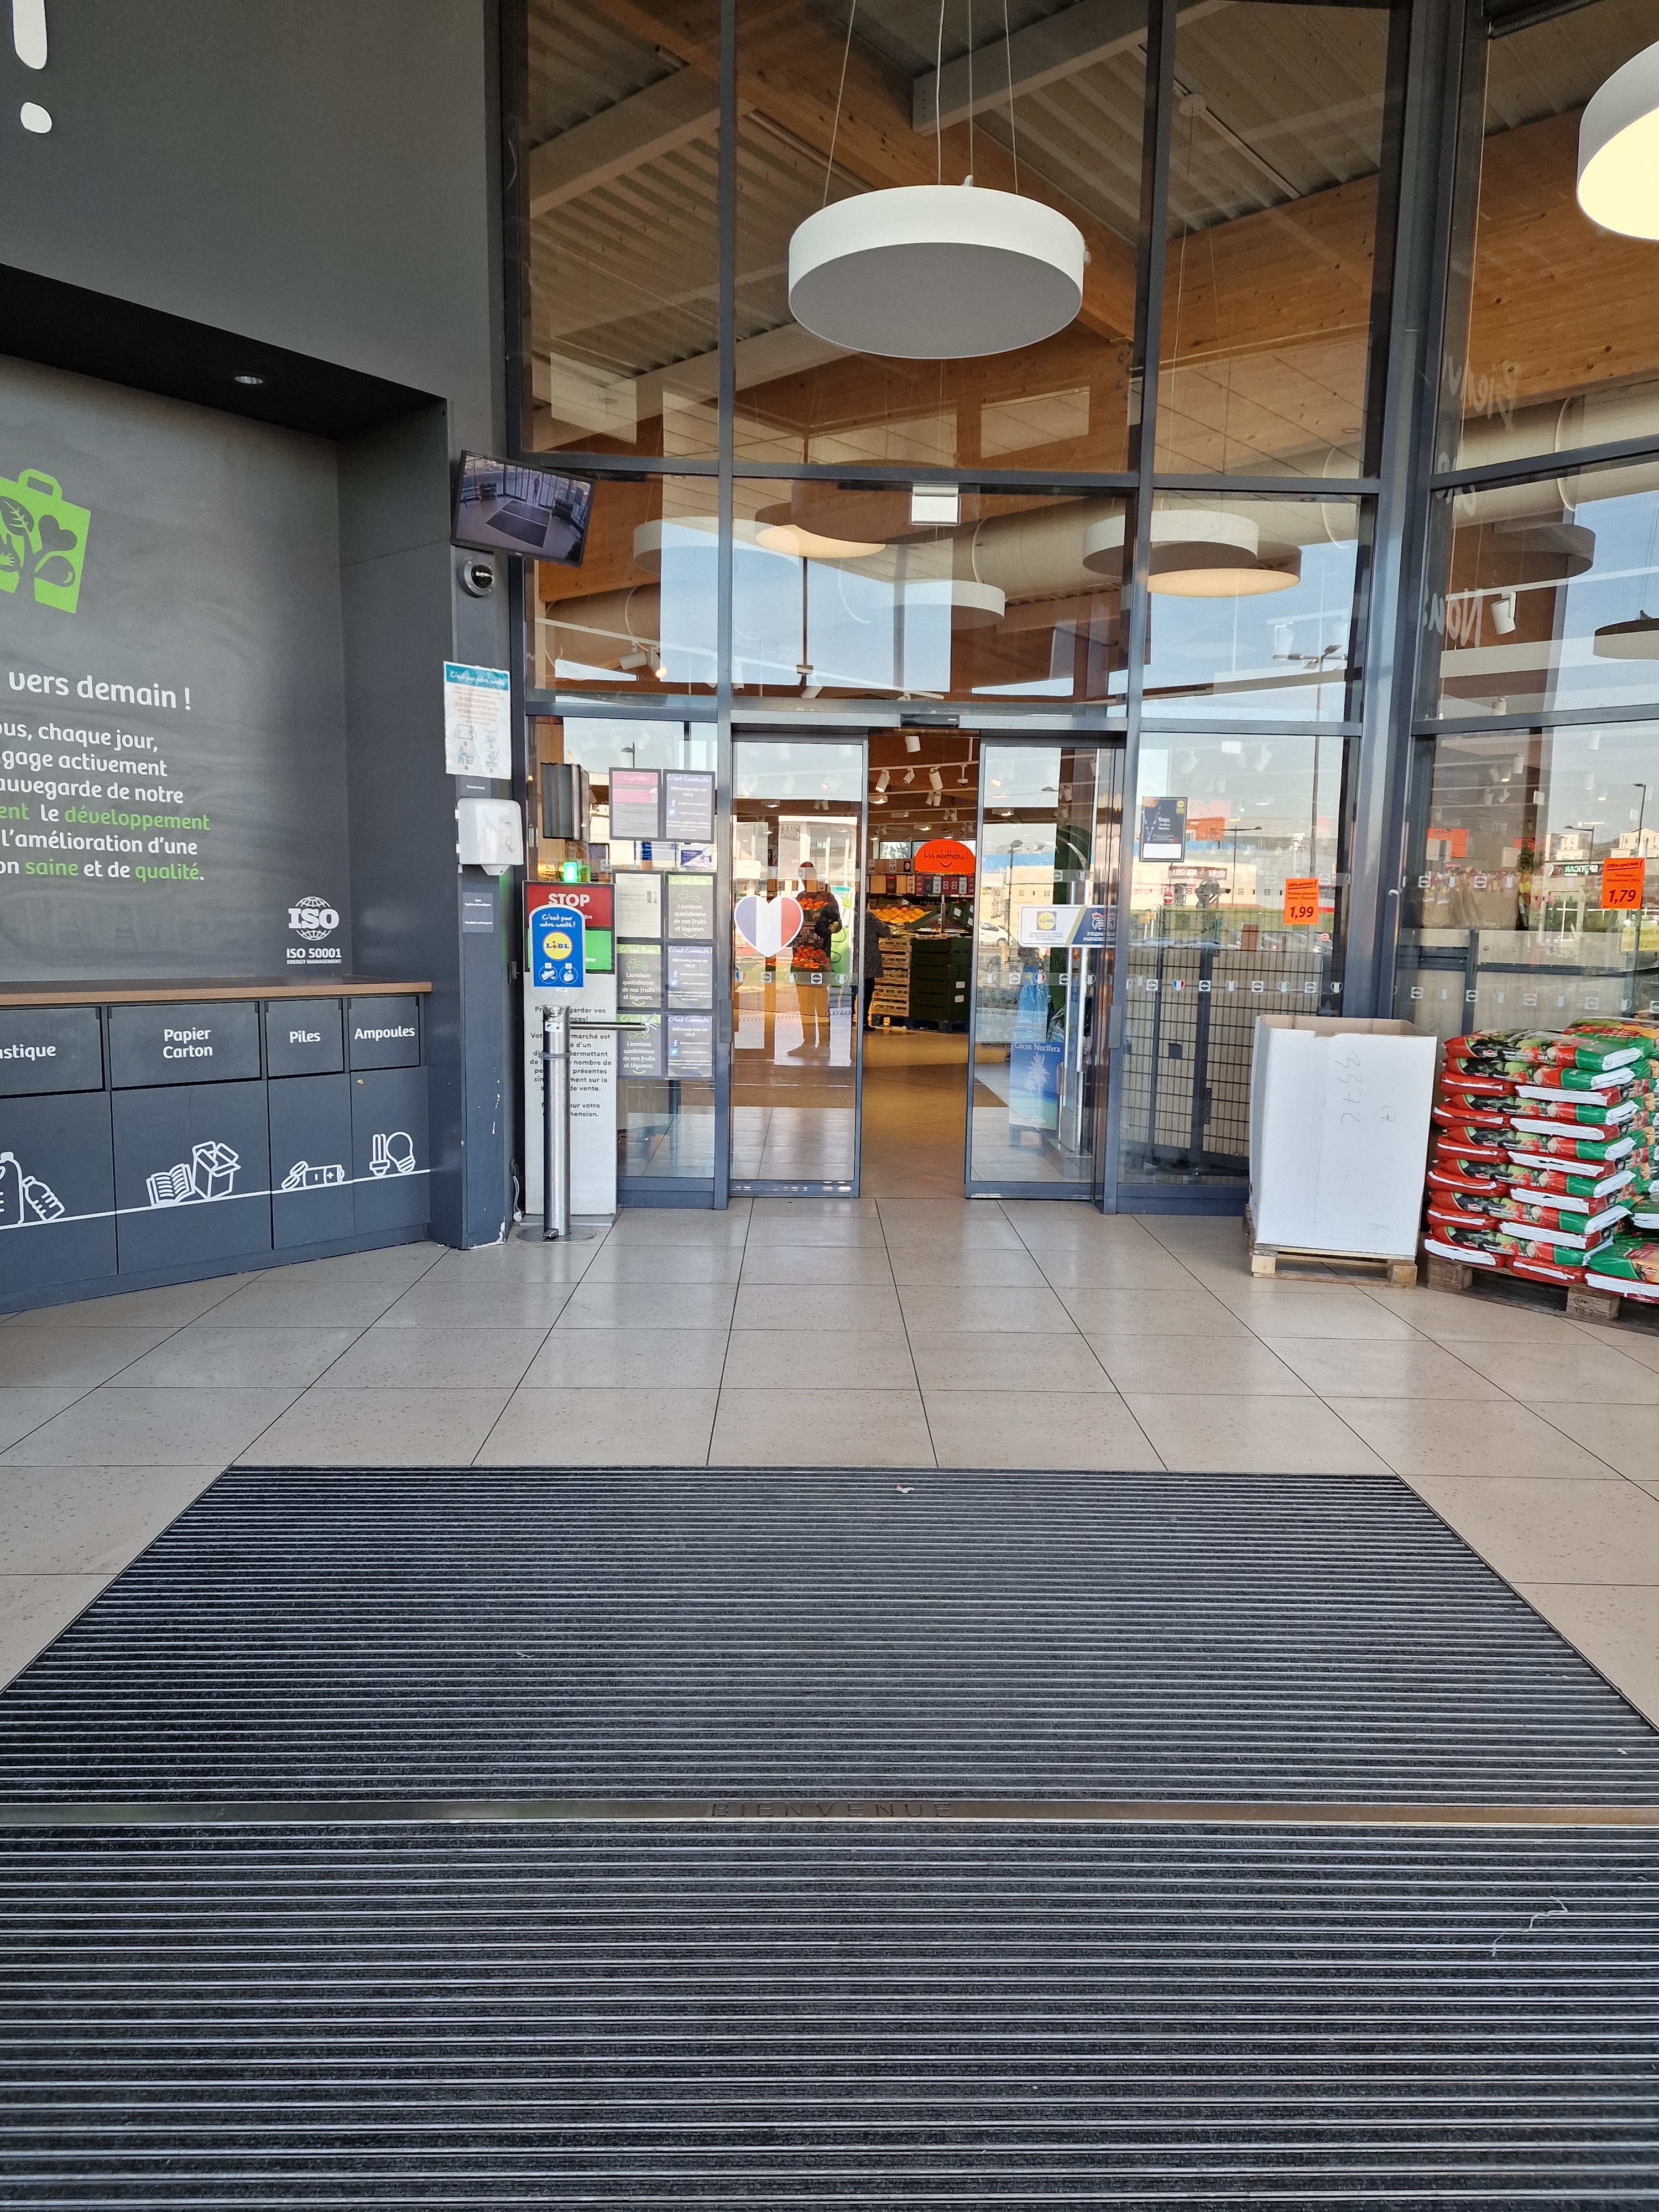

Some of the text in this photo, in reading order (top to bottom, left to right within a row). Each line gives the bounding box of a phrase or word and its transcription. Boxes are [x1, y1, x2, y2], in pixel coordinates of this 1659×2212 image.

[9, 672, 191, 710] vers demain !
[0, 722, 158, 753] us, chaque jour,
[0, 750, 168, 778] gage activement
[107, 782, 130, 800] de
[135, 786, 184, 804] notre
[41, 804, 59, 822] le
[64, 805, 210, 831] développement
[2, 830, 197, 854] l'amélioration d'une
[924, 849, 935, 858] Les
[936, 849, 965, 860] imbattables
[25, 858, 79, 875] saine
[84, 860, 103, 877] et
[108, 861, 130, 878] de
[135, 862, 204, 883] qualité.
[548, 893, 590, 907] STOP
[1609, 889, 1636, 905] 1,79
[288, 908, 339, 929] ISO
[1290, 906, 1314, 919] 1,99
[287, 948, 342, 958] ISO 50001
[164, 1027, 211, 1044] Papier
[289, 1030, 321, 1043] Piles
[354, 1026, 415, 1041] Ampoules
[0, 1044, 56, 1061] stique
[163, 1045, 212, 1059] Carton
[1015, 1042, 1060, 1052] Cocos Nucifera
[712, 1802, 952, 1817] BIENVENUE
